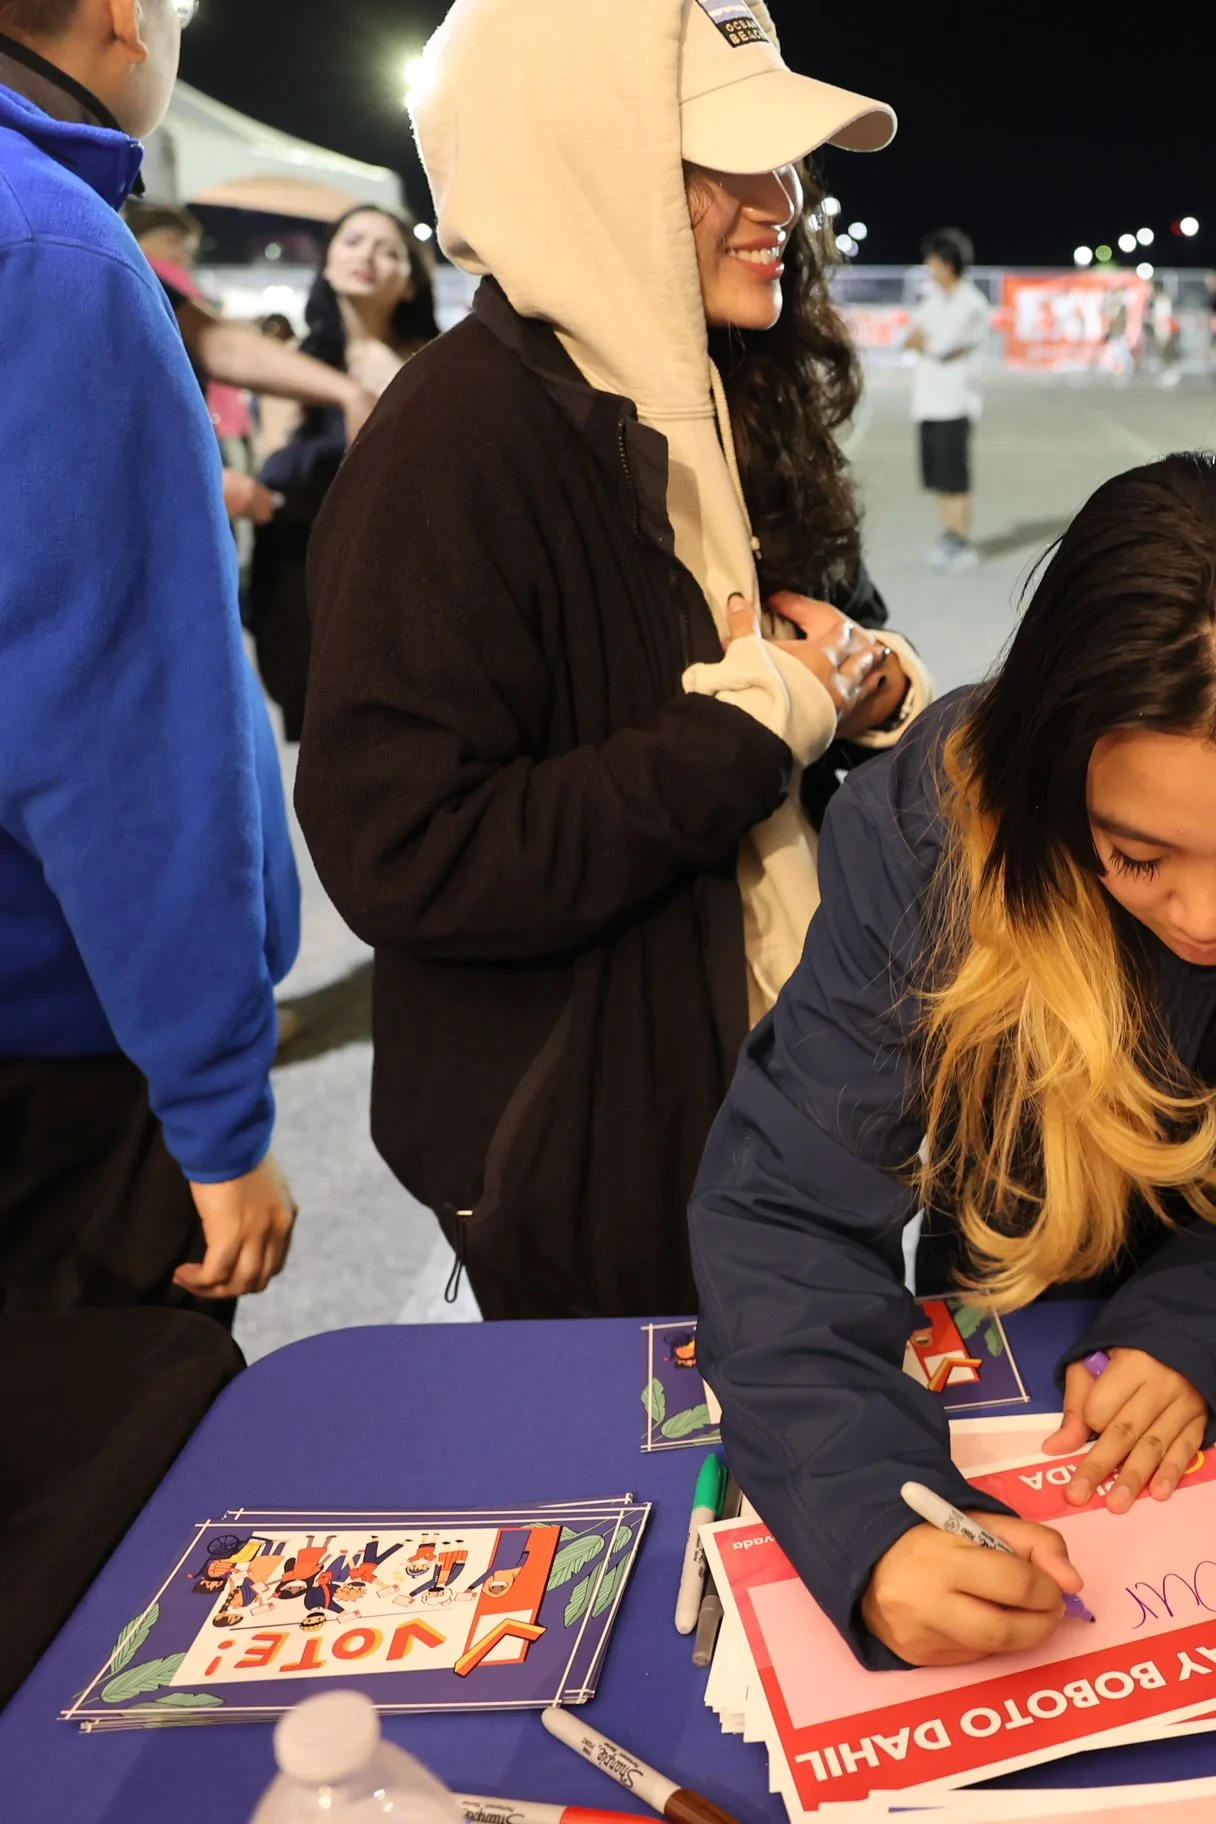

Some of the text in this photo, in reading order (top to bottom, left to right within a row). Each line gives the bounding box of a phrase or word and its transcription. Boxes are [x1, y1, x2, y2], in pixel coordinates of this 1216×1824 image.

[203, 1618, 447, 1678] VOTE!
[959, 1660, 1168, 1739] BOBOTO
[596, 1745, 644, 1789] Sharpie
[794, 1717, 953, 1781] DAHIL
